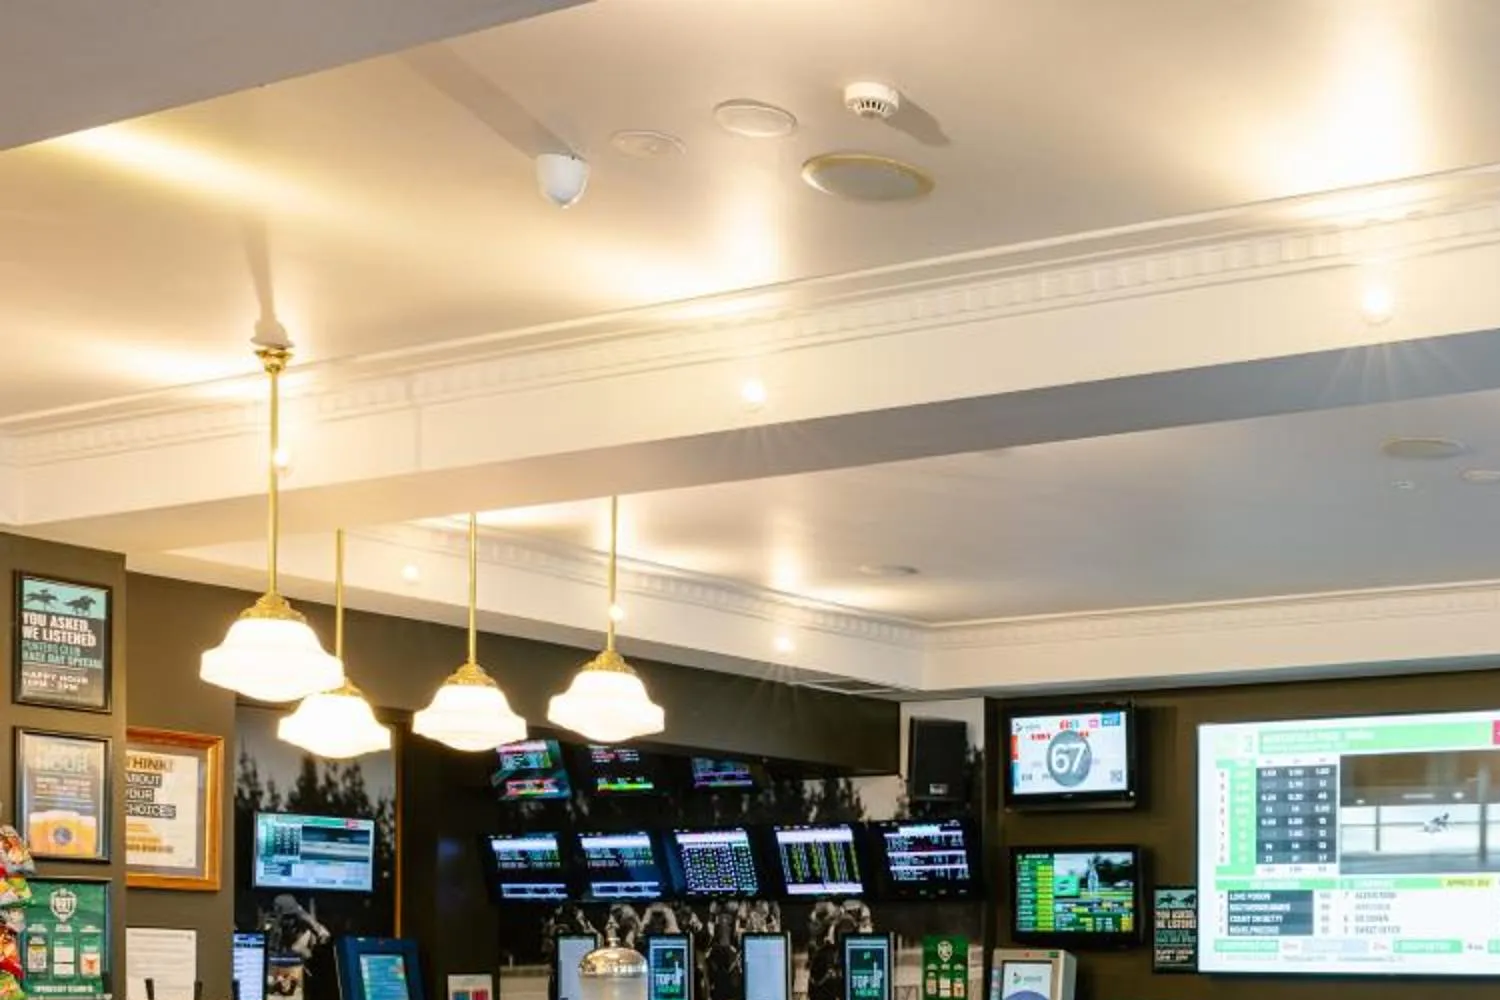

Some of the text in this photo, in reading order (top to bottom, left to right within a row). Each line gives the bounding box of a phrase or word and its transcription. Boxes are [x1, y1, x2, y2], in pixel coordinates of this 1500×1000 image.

[22, 611, 47, 627] YOU
[22, 625, 97, 647] WE LISTENED
[1051, 743, 1087, 773] 67
[852, 975, 869, 988] TOP
